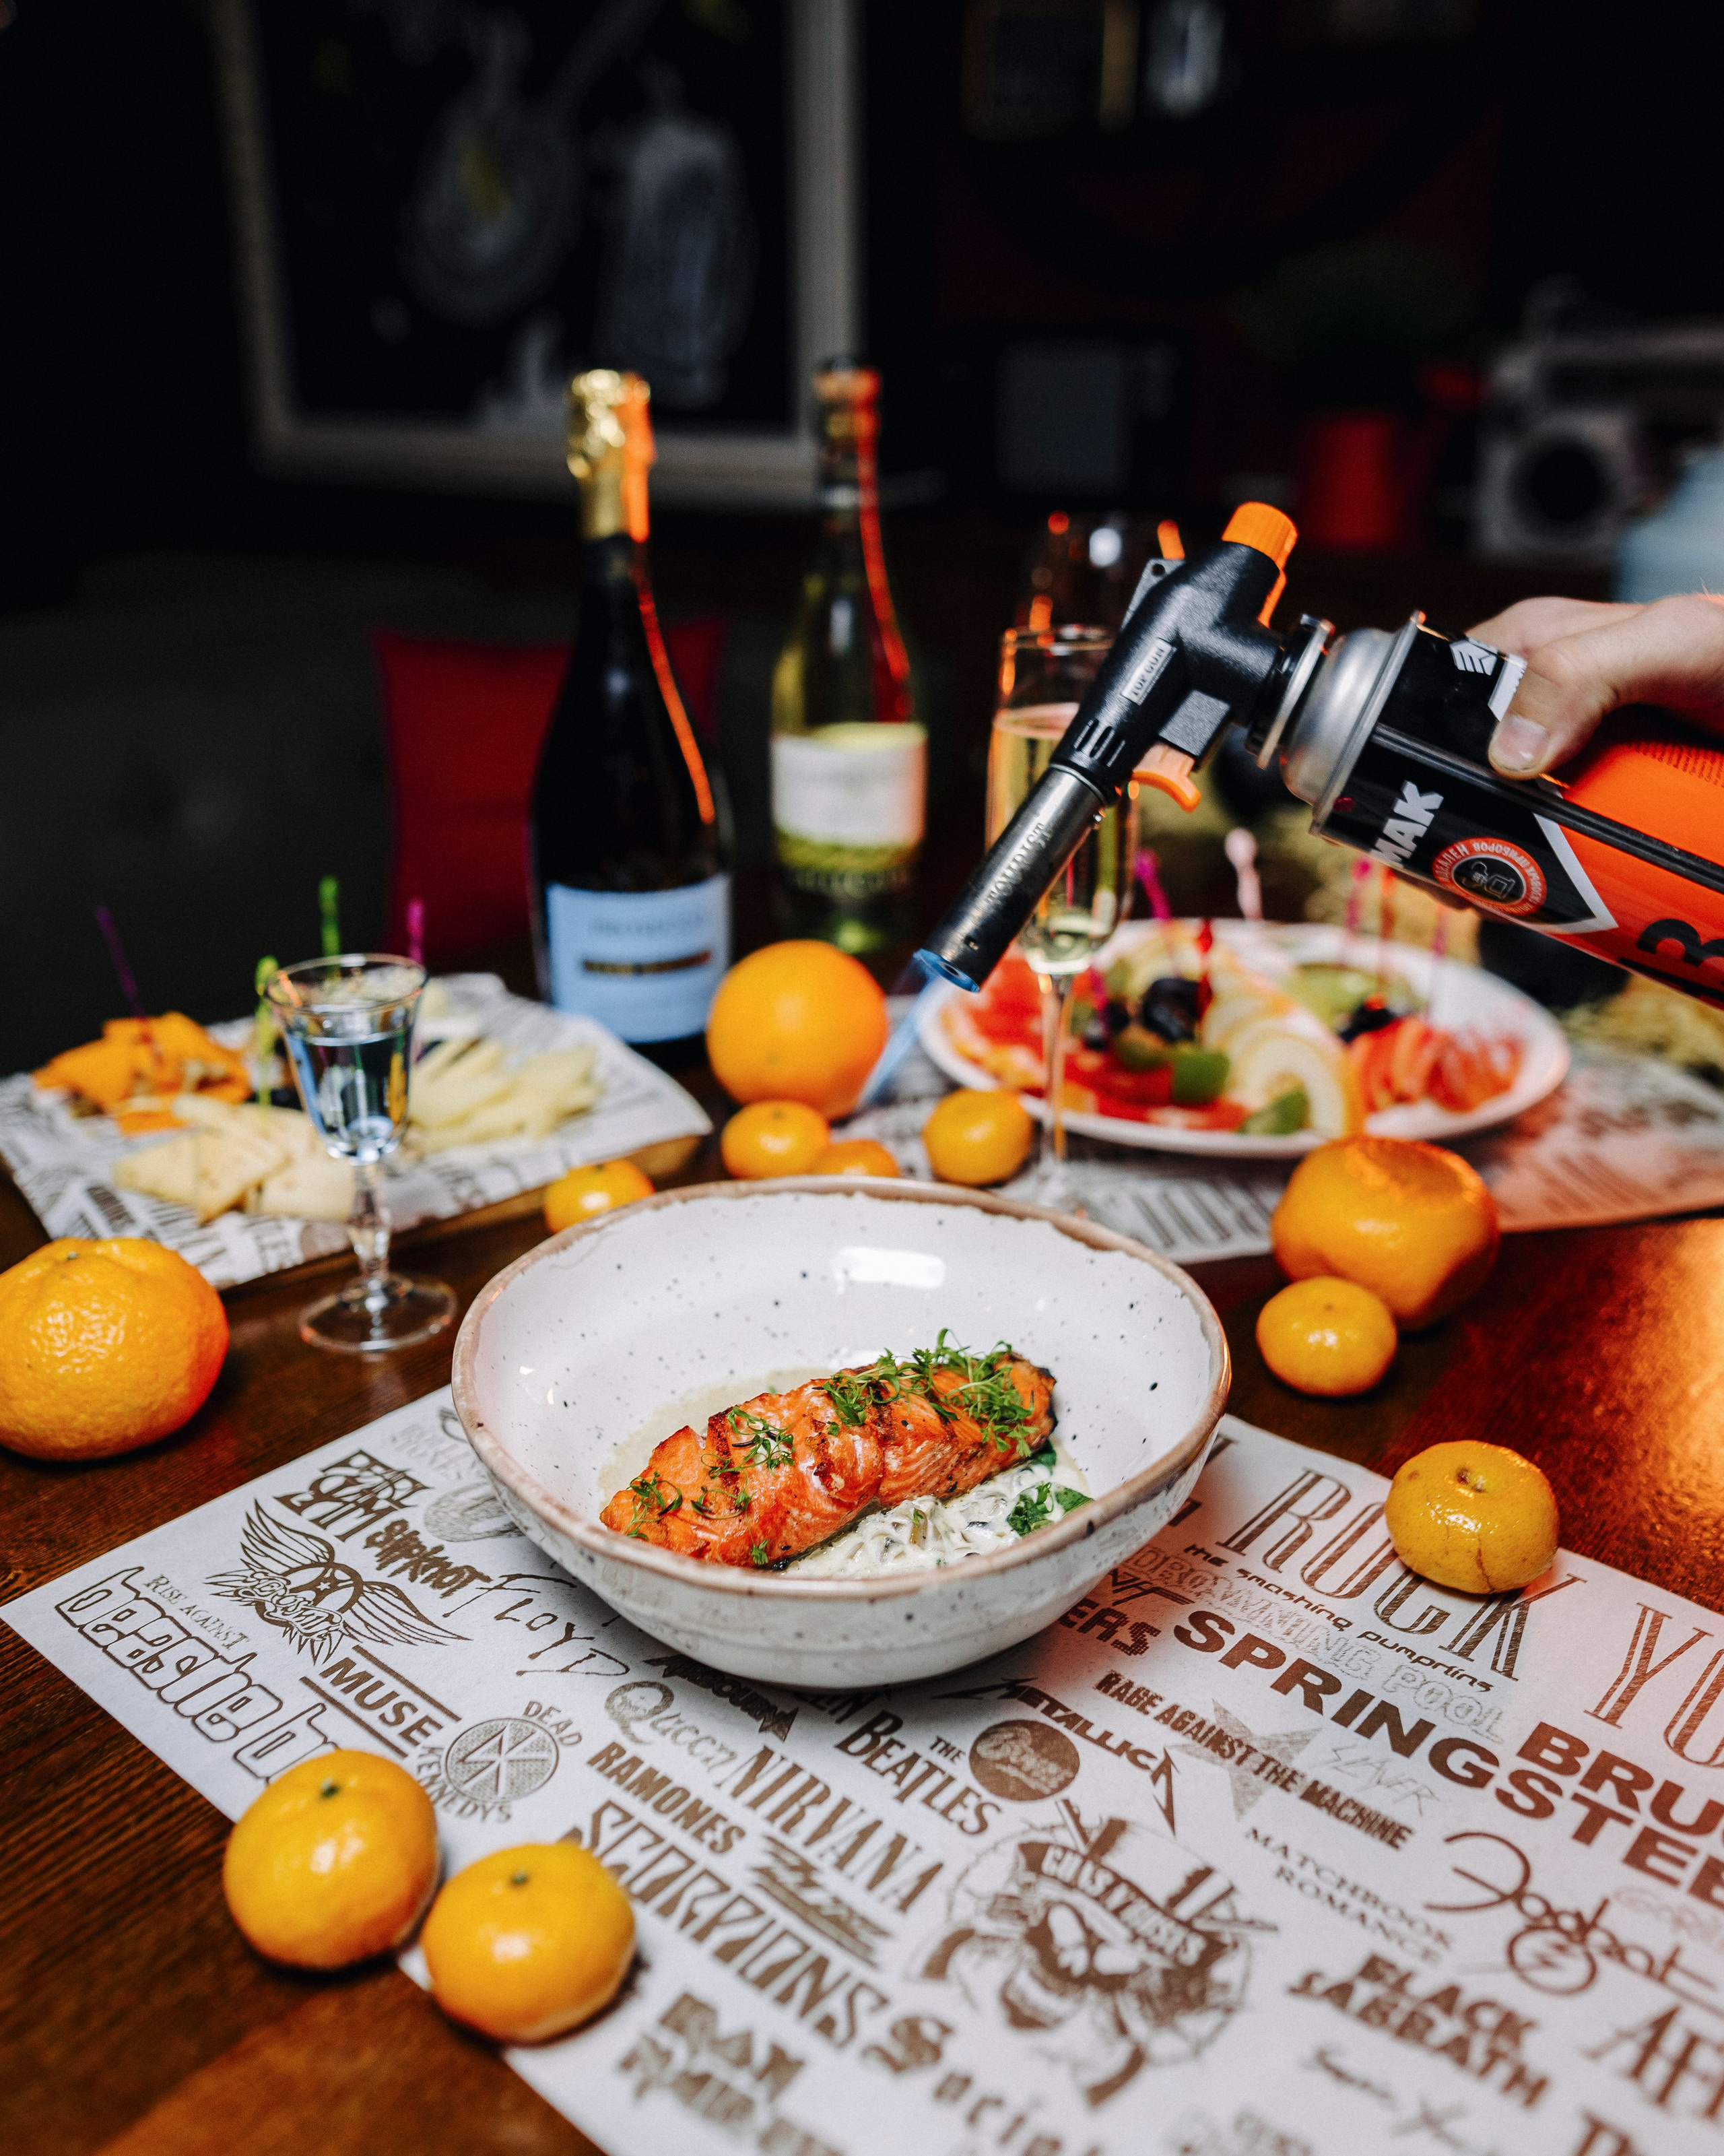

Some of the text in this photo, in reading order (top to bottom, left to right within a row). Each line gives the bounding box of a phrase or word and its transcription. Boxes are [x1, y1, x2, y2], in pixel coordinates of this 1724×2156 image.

[1055, 1598, 1162, 1657] ERS
[321, 1656, 444, 1746] MUSE
[523, 1700, 583, 1747] DEAD
[929, 1736, 967, 1763] THE
[587, 1742, 745, 1856] RAMONES
[835, 1710, 1002, 1836] BEATLES
[1517, 1722, 1724, 1849] BRU
[714, 1744, 946, 1915] NIRVANA
